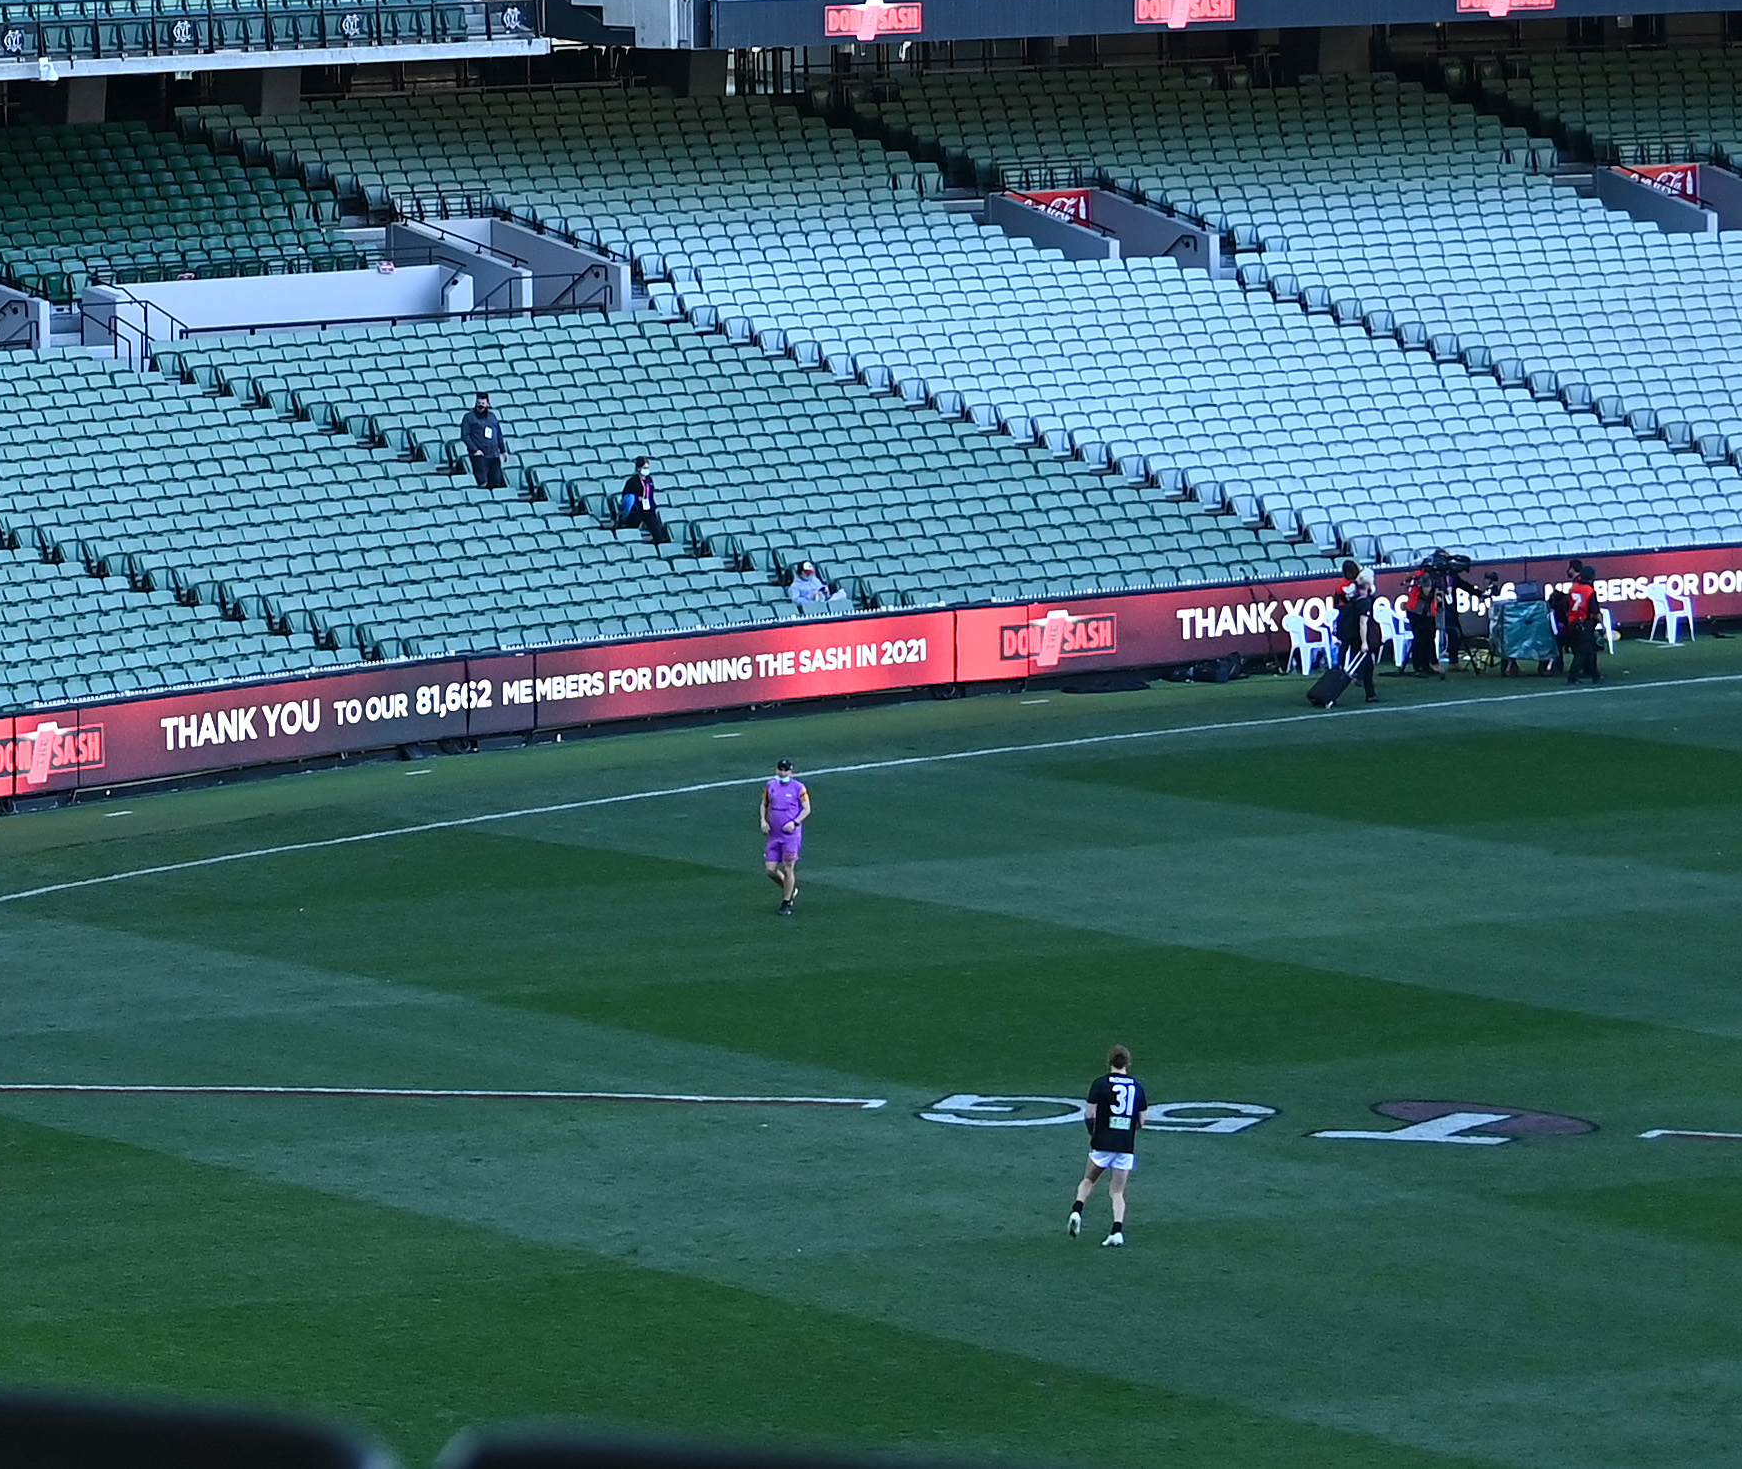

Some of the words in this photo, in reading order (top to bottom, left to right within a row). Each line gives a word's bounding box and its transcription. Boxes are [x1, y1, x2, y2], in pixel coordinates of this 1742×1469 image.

[828, 10, 862, 32] DON
[878, 7, 919, 30] SASH
[1571, 593, 1582, 611] 7
[1176, 601, 1278, 640] THANK
[1003, 626, 1041, 658] DON
[1062, 620, 1113, 651] SASH
[161, 706, 258, 751] THANK
[262, 698, 321, 737] YOU
[333, 699, 363, 726] TO
[365, 693, 409, 721] OUR
[415, 680, 493, 718] 81,662
[502, 672, 605, 706] MEMBERS
[608, 666, 652, 693] FOR
[655, 656, 753, 690] DONNING
[756, 651, 796, 678] THE
[799, 644, 852, 673] SASH
[856, 643, 878, 668] IN
[881, 638, 928, 665] 2021
[53, 732, 102, 766] SASH
[1109, 1083, 1136, 1116] 31
